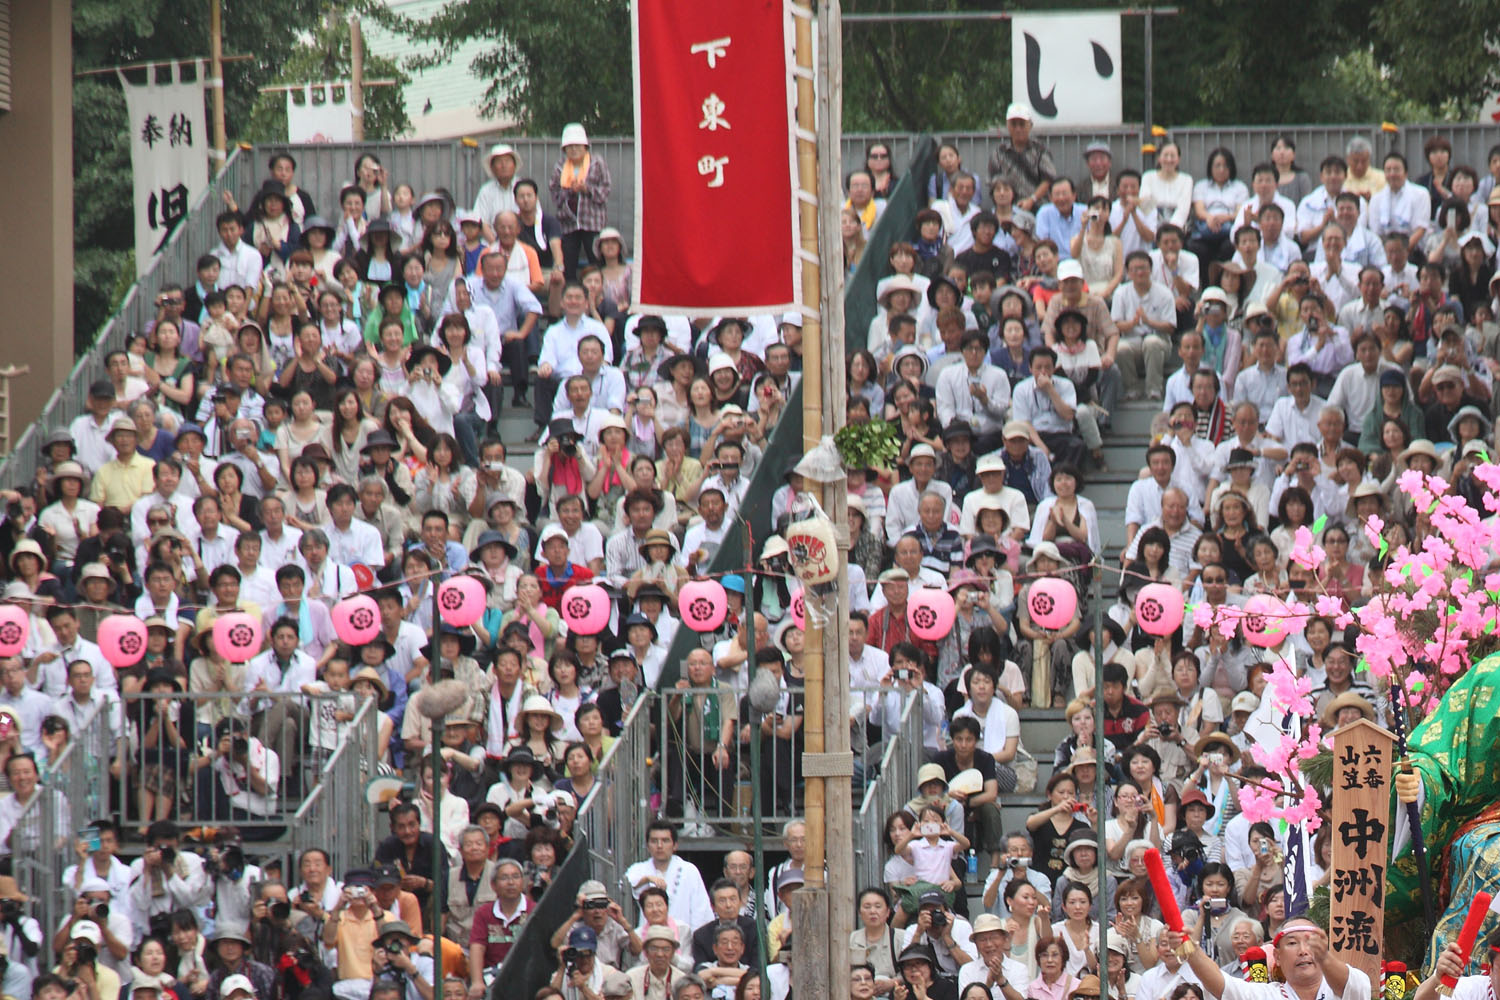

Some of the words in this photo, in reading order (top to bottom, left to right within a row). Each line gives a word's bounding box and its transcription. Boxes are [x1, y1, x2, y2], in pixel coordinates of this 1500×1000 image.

[141, 111, 193, 149] 奉納
[691, 36, 732, 188] 下東町
[1340, 745, 1363, 790] 山笠
[1363, 745, 1385, 789] 六番
[1333, 808, 1386, 956] 中洲流
